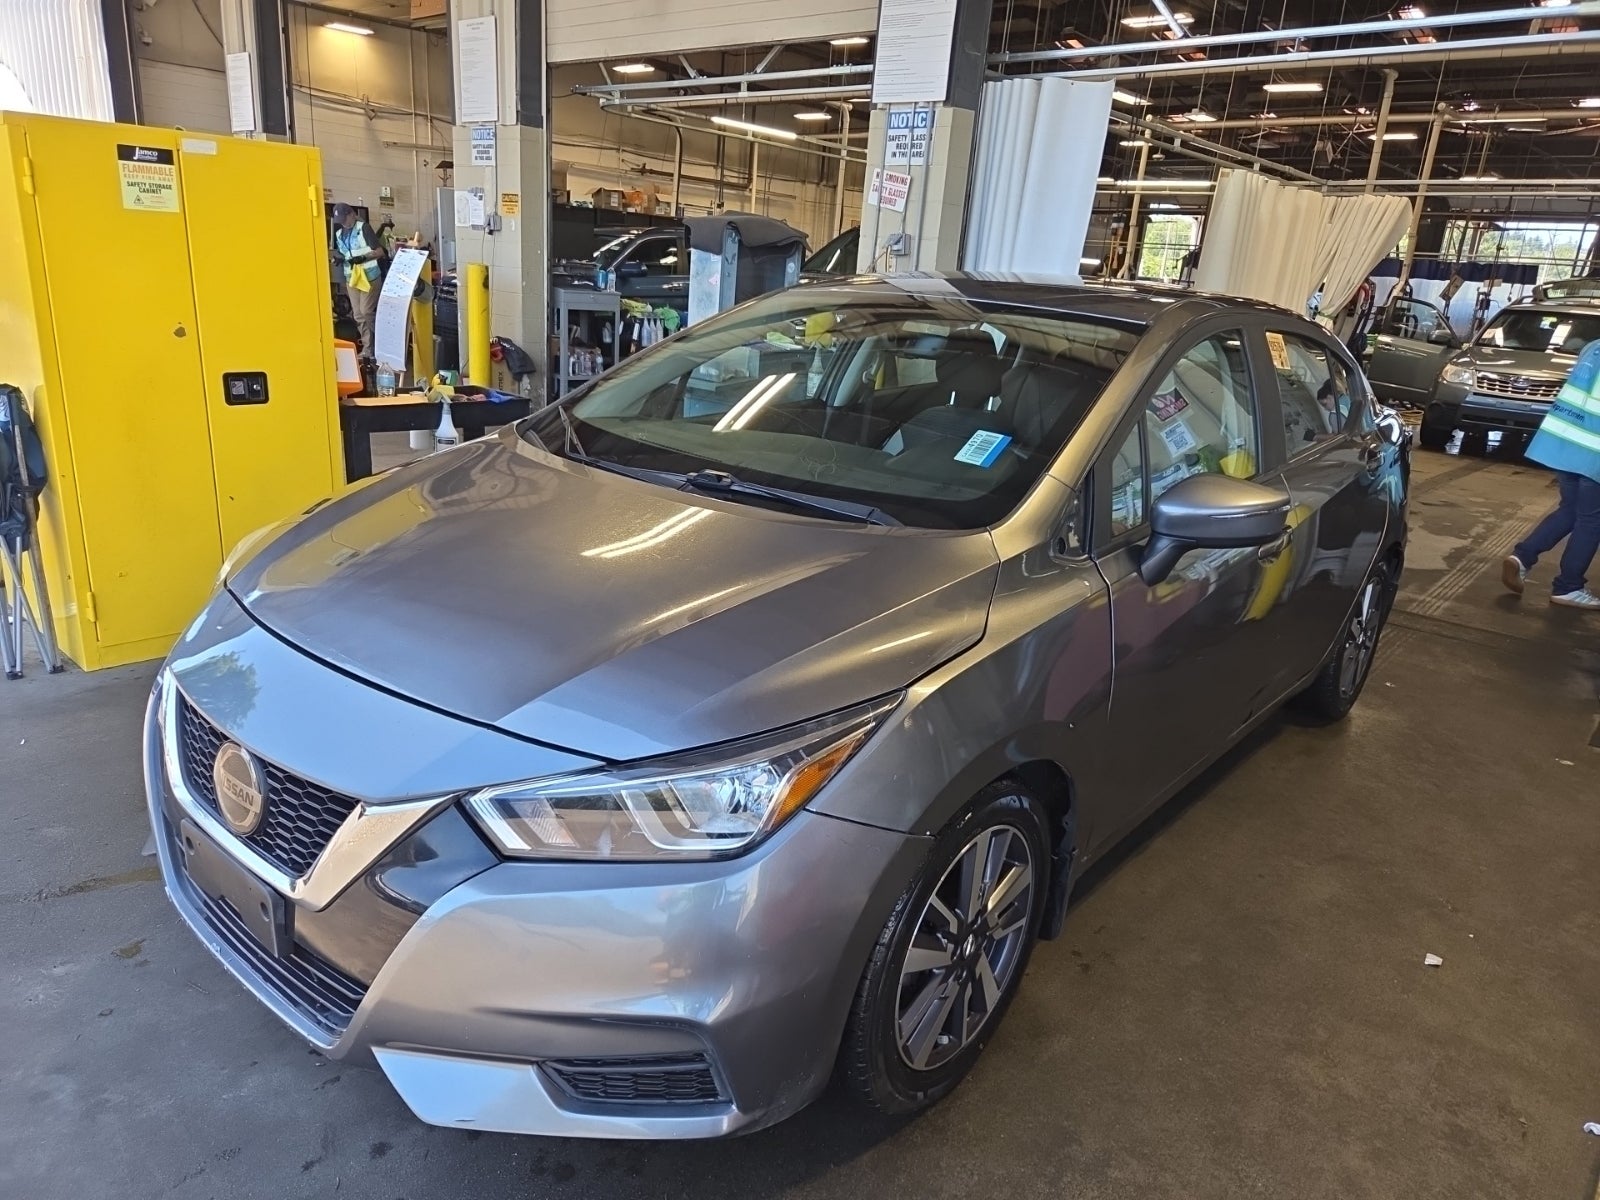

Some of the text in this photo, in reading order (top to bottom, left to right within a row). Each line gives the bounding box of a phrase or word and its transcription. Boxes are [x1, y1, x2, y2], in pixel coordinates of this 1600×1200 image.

[890, 112, 927, 128] NOTIC
[472, 129, 494, 140] NOTICE
[888, 134, 908, 142] SAFETY
[133, 146, 158, 160] Jamco
[891, 150, 897, 158] IN
[122, 163, 174, 177] FLAMMABLE
[884, 173, 908, 185] SMOKING
[126, 180, 173, 191] SAFETY STORAGE
[138, 187, 162, 195] CABINET
[872, 183, 906, 199] SATY GLASSES
[880, 196, 897, 207] EQUIRED
[223, 774, 254, 807] ISSAN
